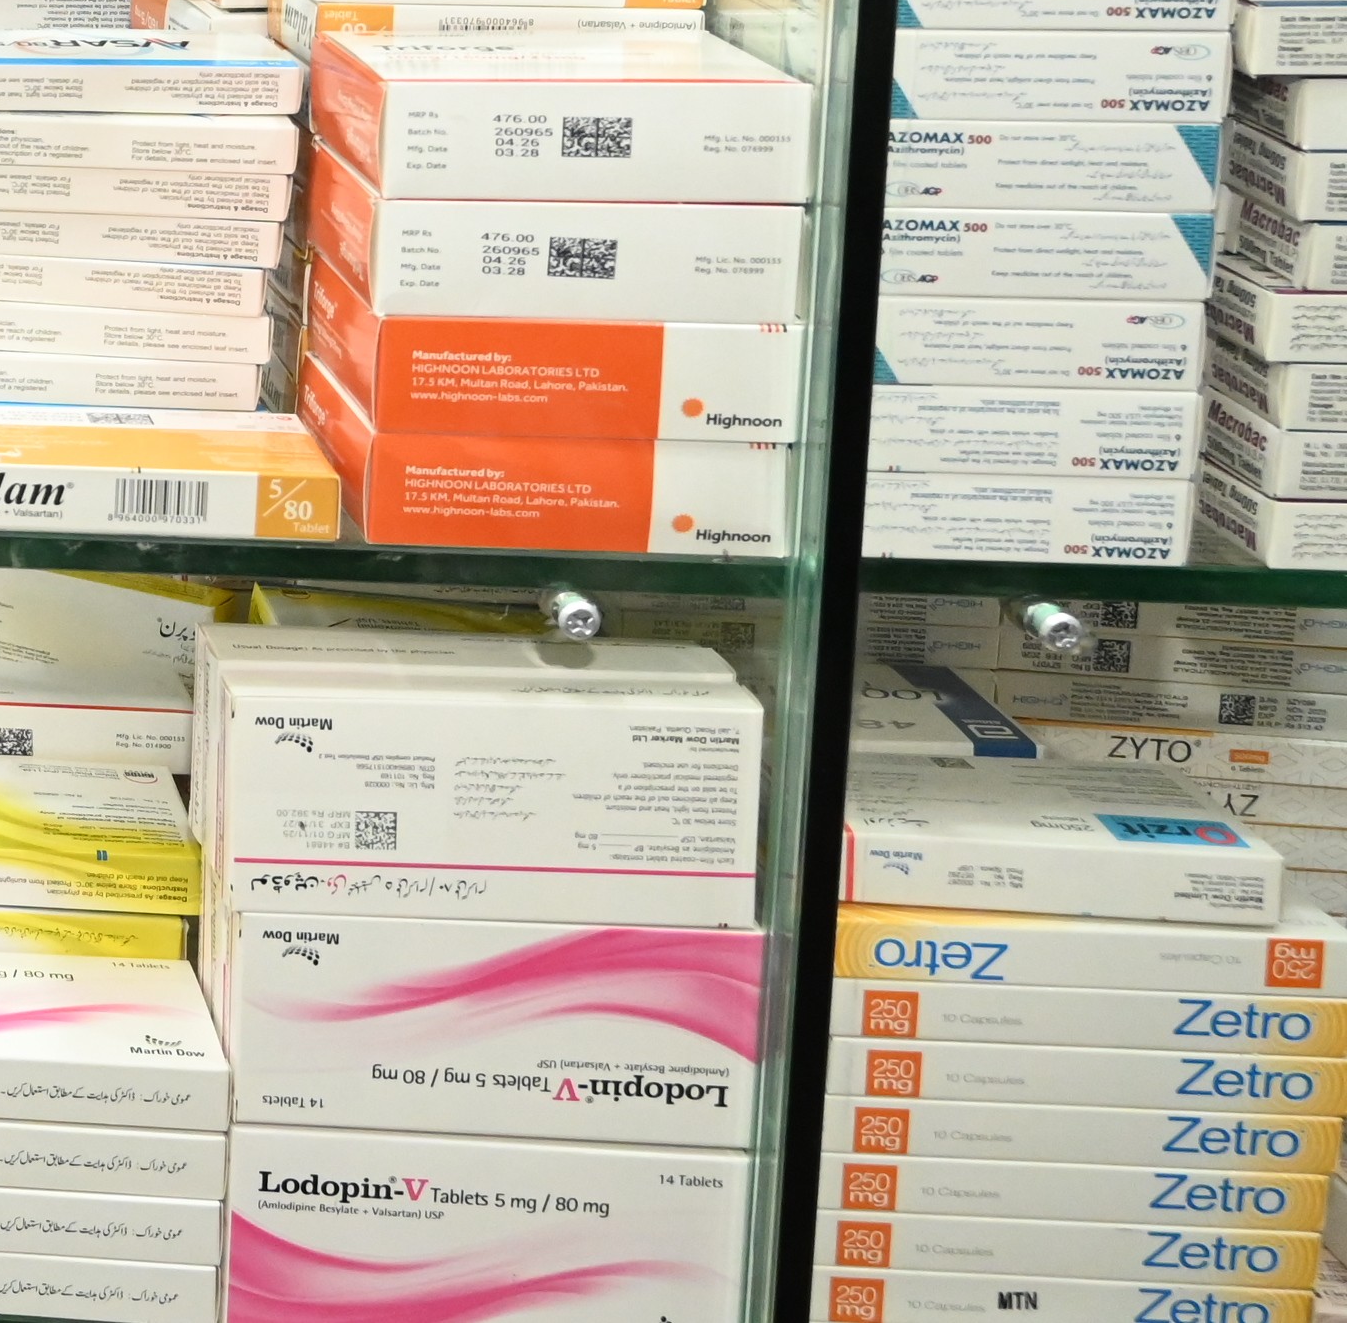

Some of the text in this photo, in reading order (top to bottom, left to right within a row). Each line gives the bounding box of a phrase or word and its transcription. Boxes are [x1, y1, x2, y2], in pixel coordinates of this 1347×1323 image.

[493, 114, 547, 123] 476.00
[495, 128, 553, 136] 260965
[887, 132, 992, 144] AZOMAX 500
[495, 138, 539, 147] 04.26
[495, 148, 539, 157] 03.28
[883, 220, 987, 232] AZOMAX 500
[412, 350, 511, 363] Manufactured by:
[411, 364, 600, 378] HIGHNOON LABORATORIES LTD
[411, 377, 628, 393] 17.5 KM, Multan Road, Lahore, Pakistan.
[411, 390, 547, 404] www.highnoon-labs.com
[707, 414, 782, 428] Highnoon
[1072, 457, 1179, 471] AZOMAX 500
[293, 522, 329, 534] Tablet
[696, 529, 771, 544] Highnoon
[255, 716, 332, 729] Martin Dow
[1108, 736, 1192, 763] ZYTO
[1118, 822, 1239, 845] Orzit
[875, 938, 1007, 980] Zetro
[1275, 943, 1318, 959] mg
[1272, 962, 1315, 978] 250
[870, 1000, 910, 1019] 250
[870, 1019, 909, 1034] mg
[1173, 1000, 1312, 1040] Zetro
[130, 1046, 205, 1058] Martin Dow
[372, 1065, 398, 1081] mg
[402, 1067, 425, 1083] 80
[445, 1068, 471, 1085] mg
[476, 1071, 485, 1086] 5
[1176, 1059, 1312, 1100] Zetro
[493, 1072, 551, 1092] Tablets
[553, 1074, 729, 1107] Lodopin-V
[1163, 1117, 1299, 1157] Zetro
[659, 1175, 723, 1188] 14 Tablets
[259, 1171, 429, 1205] Lodopin-V
[431, 1186, 488, 1207] Tablets
[495, 1193, 505, 1207] 5
[510, 1198, 536, 1213] mg
[555, 1196, 579, 1211] 80
[583, 1202, 610, 1217] mg
[1150, 1174, 1285, 1214] Zetro
[1142, 1232, 1278, 1273] Zetro
[998, 1293, 1037, 1310] MTN
[1135, 1289, 1270, 1323] Zetro
